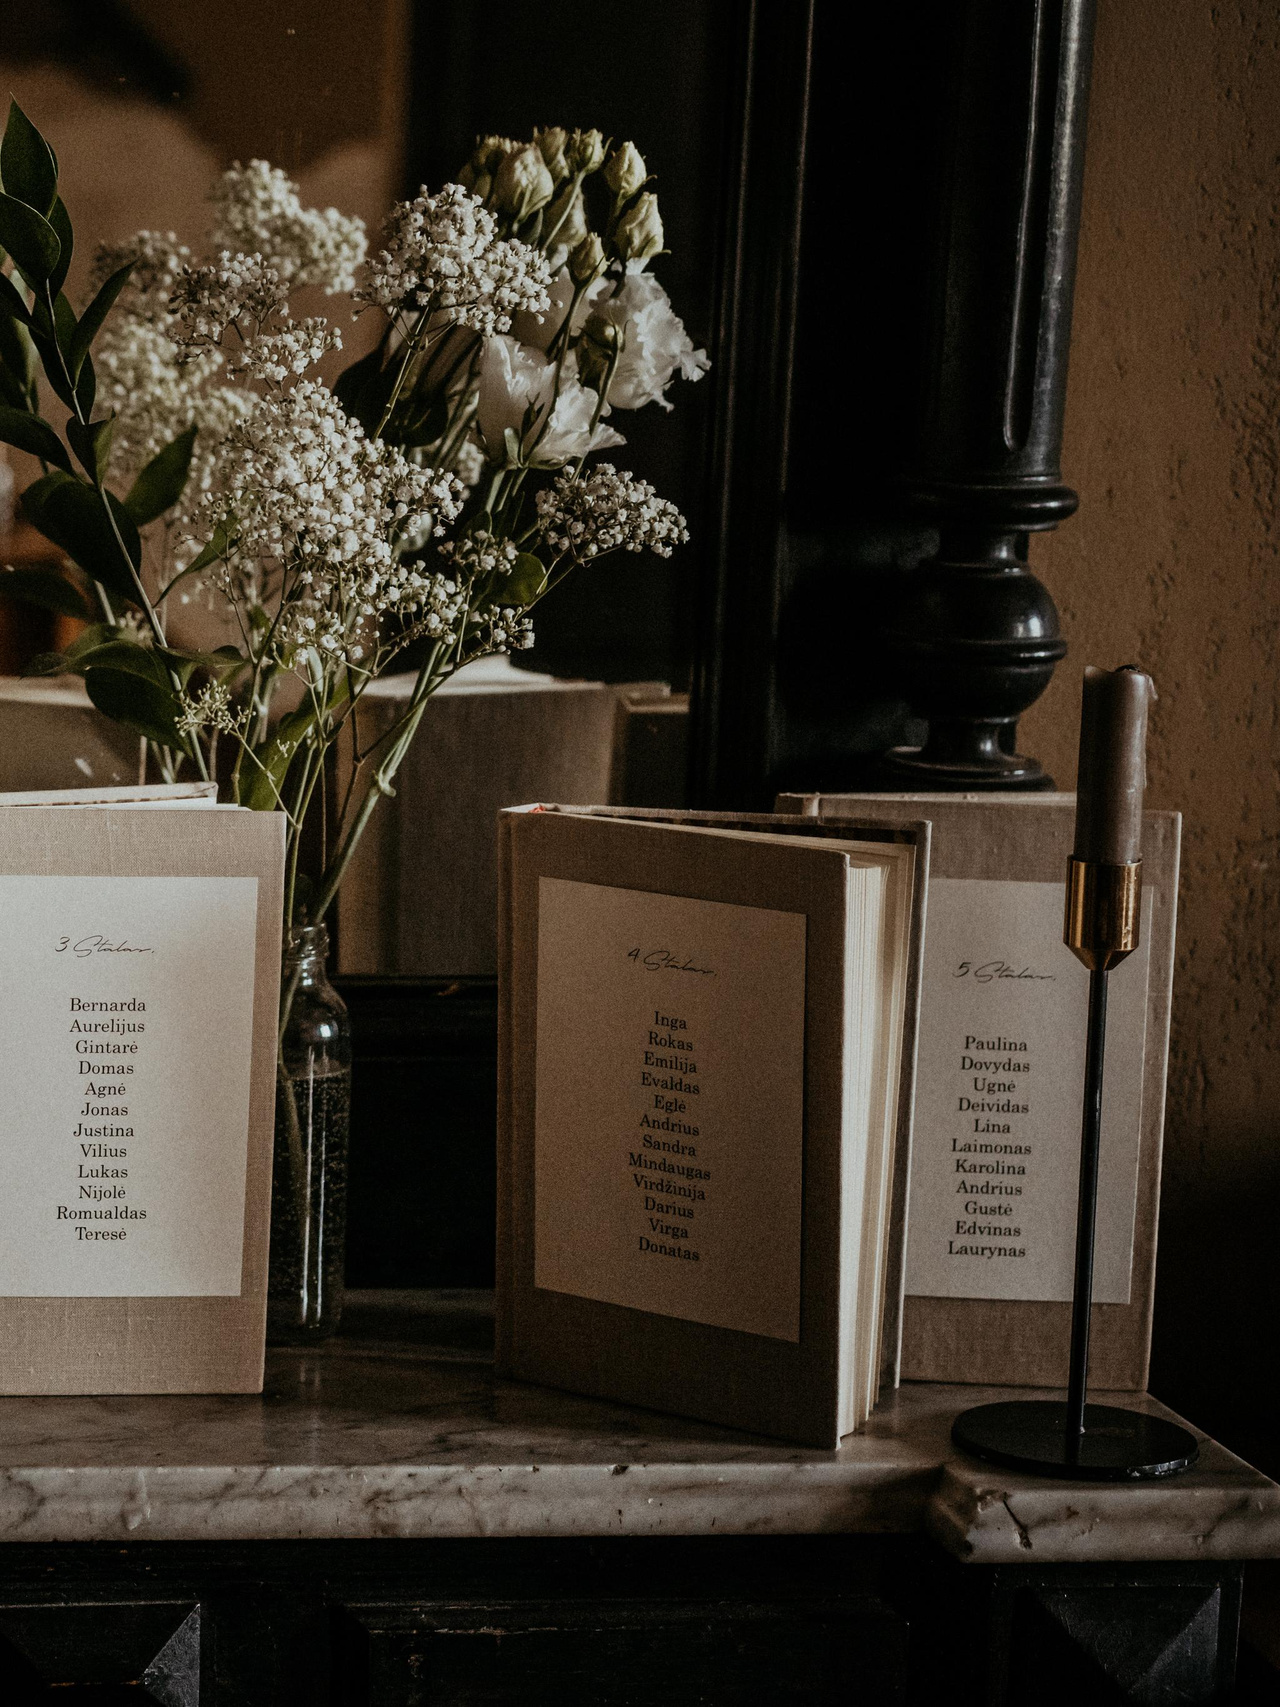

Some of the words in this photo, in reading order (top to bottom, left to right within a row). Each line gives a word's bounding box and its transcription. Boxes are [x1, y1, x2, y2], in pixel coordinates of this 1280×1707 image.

[55, 937, 70, 952] 3
[628, 949, 640, 962] 4
[953, 962, 971, 978] 5
[70, 998, 146, 1012] Bernarda
[69, 1019, 145, 1035] Aurelijus
[654, 1011, 687, 1031] Inga
[76, 1040, 138, 1054] Gintarė
[648, 1031, 693, 1051] Rokas
[965, 1036, 1028, 1051] Paulina
[79, 1061, 134, 1074] Domas
[644, 1051, 697, 1074] Emilija
[961, 1056, 1030, 1074] Dovydas
[84, 1082, 126, 1098] Agnė
[641, 1071, 700, 1094] Evaldas
[973, 1077, 1016, 1095] Ugnė
[81, 1102, 128, 1116] Jonas
[654, 1095, 686, 1113] Eglė
[958, 1097, 1030, 1114] Deividas
[73, 1123, 134, 1137] Justina
[640, 1114, 700, 1136] Andrius
[974, 1118, 1011, 1133] Lina
[80, 1144, 127, 1157] Vilius
[643, 1134, 696, 1157] Sandra
[951, 1138, 1032, 1155] Laimonas
[78, 1164, 128, 1178] Lukas
[629, 1152, 711, 1180] Mindaugas
[955, 1159, 1026, 1175] Karolina
[79, 1185, 126, 1202] Nijolė
[633, 1174, 705, 1201] Virdžinija
[956, 1180, 1023, 1195] Andrius
[57, 1206, 147, 1220] Romualdas
[644, 1196, 694, 1219] Darius
[965, 1201, 1013, 1215] Gustė
[75, 1227, 126, 1240] Teresė
[649, 1218, 688, 1240] Virga
[955, 1221, 1021, 1237] Edvinas
[639, 1237, 700, 1261] Donatas
[947, 1241, 1026, 1259] Laurynas
